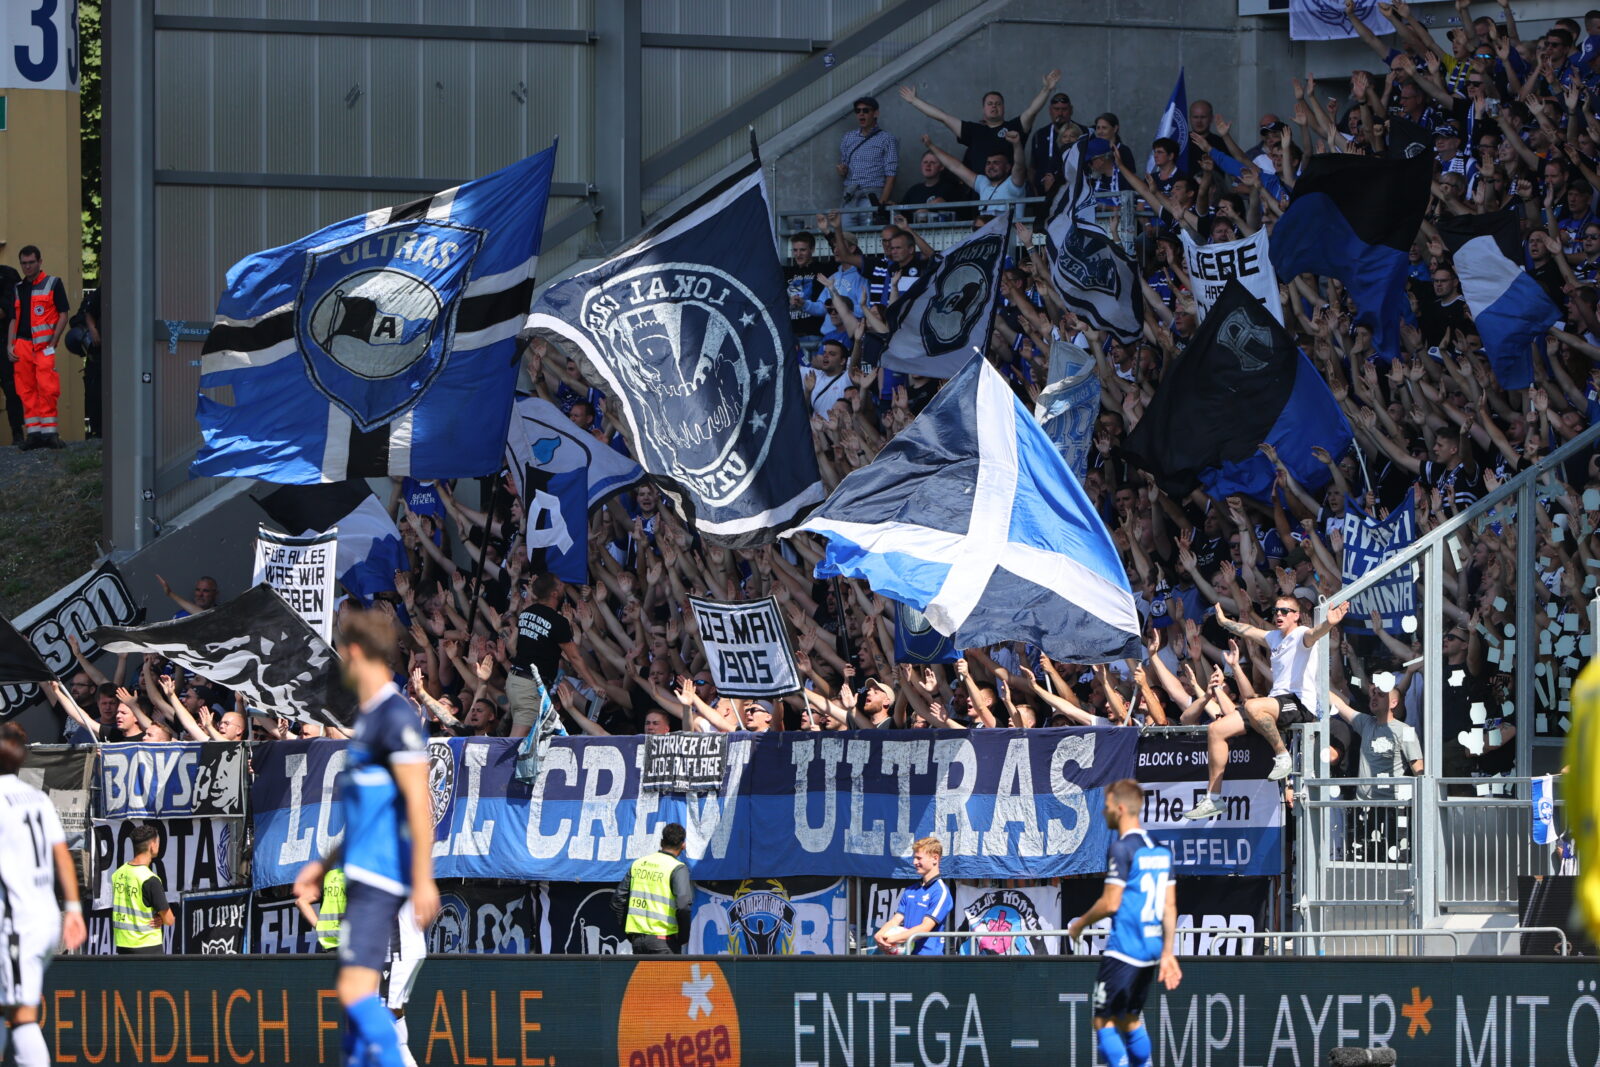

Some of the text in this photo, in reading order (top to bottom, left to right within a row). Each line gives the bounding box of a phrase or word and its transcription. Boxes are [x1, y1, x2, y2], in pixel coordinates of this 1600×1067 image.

[14, 0, 58, 82] 3
[339, 231, 460, 270] ULTRAS
[1187, 242, 1260, 280] LIEBE
[265, 546, 326, 565] FÜR ALLES
[265, 565, 325, 586] WAS WIR
[718, 651, 773, 684] 1905
[700, 735, 721, 755] ALS
[1138, 749, 1250, 767] BLOCK 6 SIN 1998
[103, 751, 198, 815] BOYS
[672, 756, 722, 777] AUFLAGE
[526, 740, 752, 862] CREW
[792, 733, 1097, 857] ULTRAS
[1142, 787, 1251, 823] The Frm
[23, 810, 47, 868] 11
[631, 898, 648, 909] 190
[425, 989, 557, 1066] ALLE.
[794, 991, 986, 1067] ENTEGA
[1058, 991, 1397, 1067] TMPLAYER
[1456, 995, 1550, 1067] MIT
